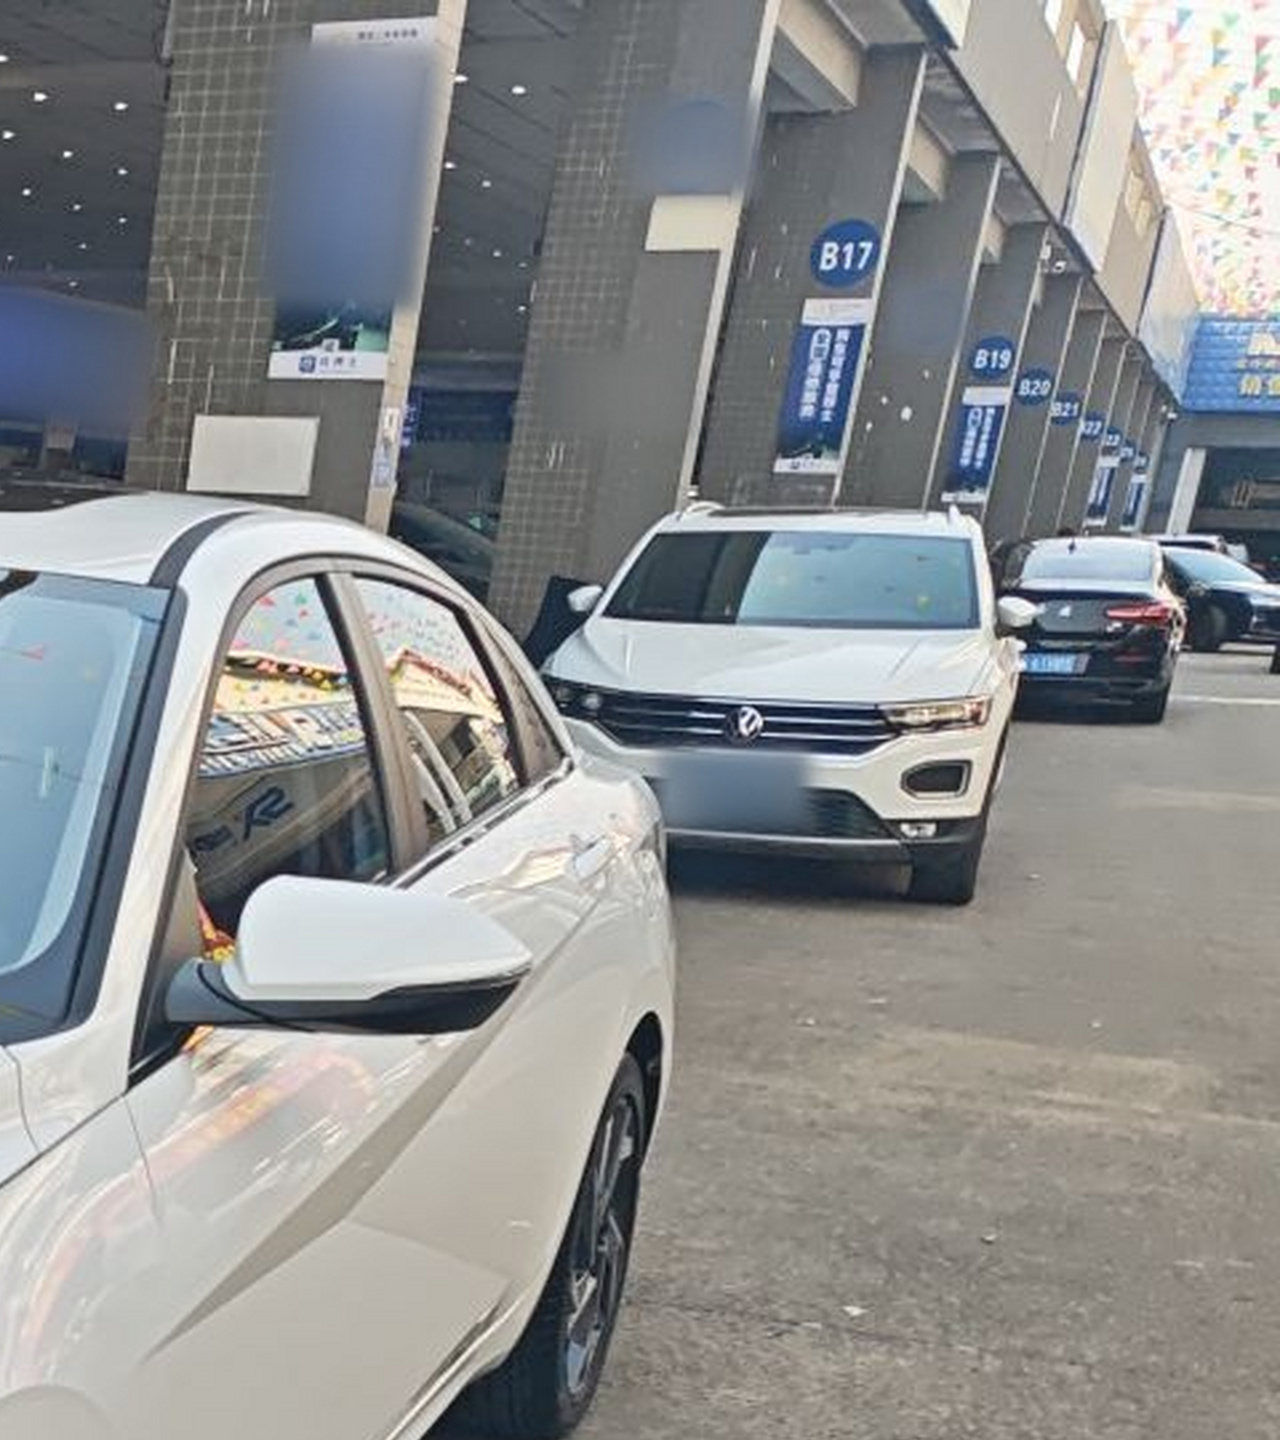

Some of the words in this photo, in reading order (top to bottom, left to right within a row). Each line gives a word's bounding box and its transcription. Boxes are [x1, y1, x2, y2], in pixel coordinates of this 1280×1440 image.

[819, 241, 873, 271] B17
[973, 348, 1012, 369] B19
[1018, 378, 1052, 396] B20
